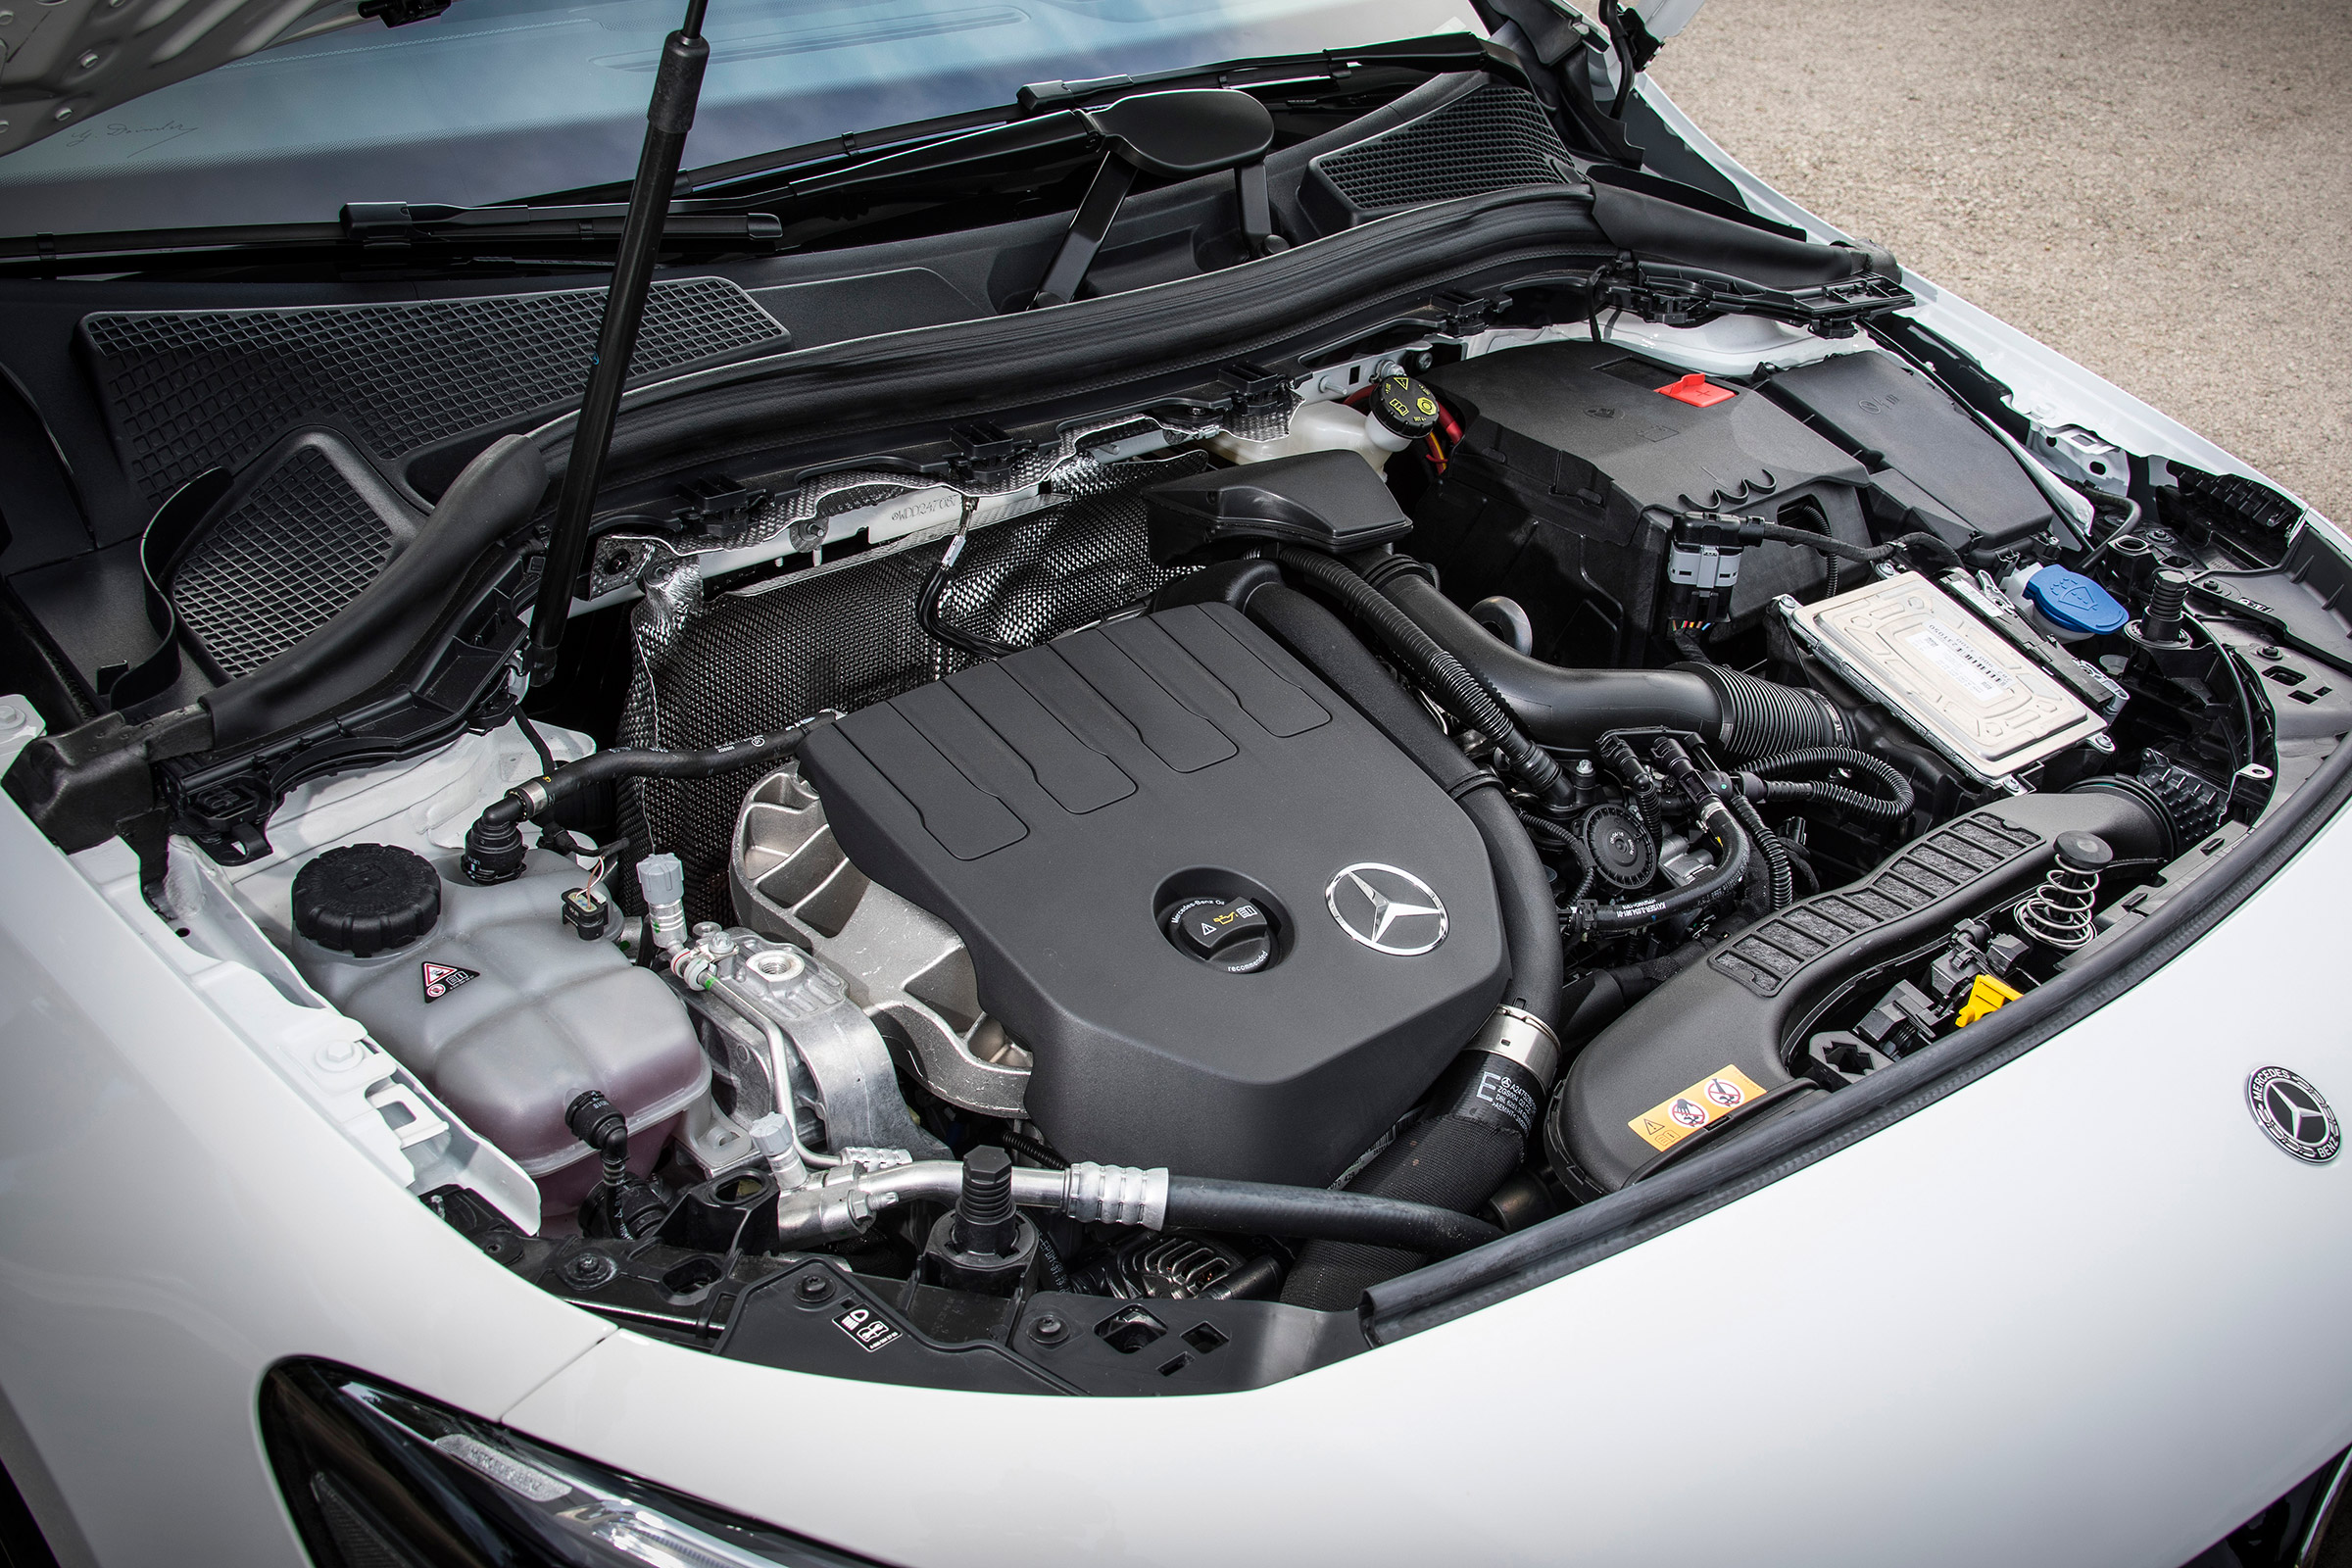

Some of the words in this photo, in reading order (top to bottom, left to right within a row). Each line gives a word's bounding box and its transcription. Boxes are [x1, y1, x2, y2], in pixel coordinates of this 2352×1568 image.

[1171, 900, 1214, 924] Mercedes-Benz
[1227, 950, 1268, 972] recommended
[1476, 1071, 1501, 1102] E
[2252, 1068, 2291, 1102] MERCEDES
[2317, 1136, 2339, 1158] BENZ
